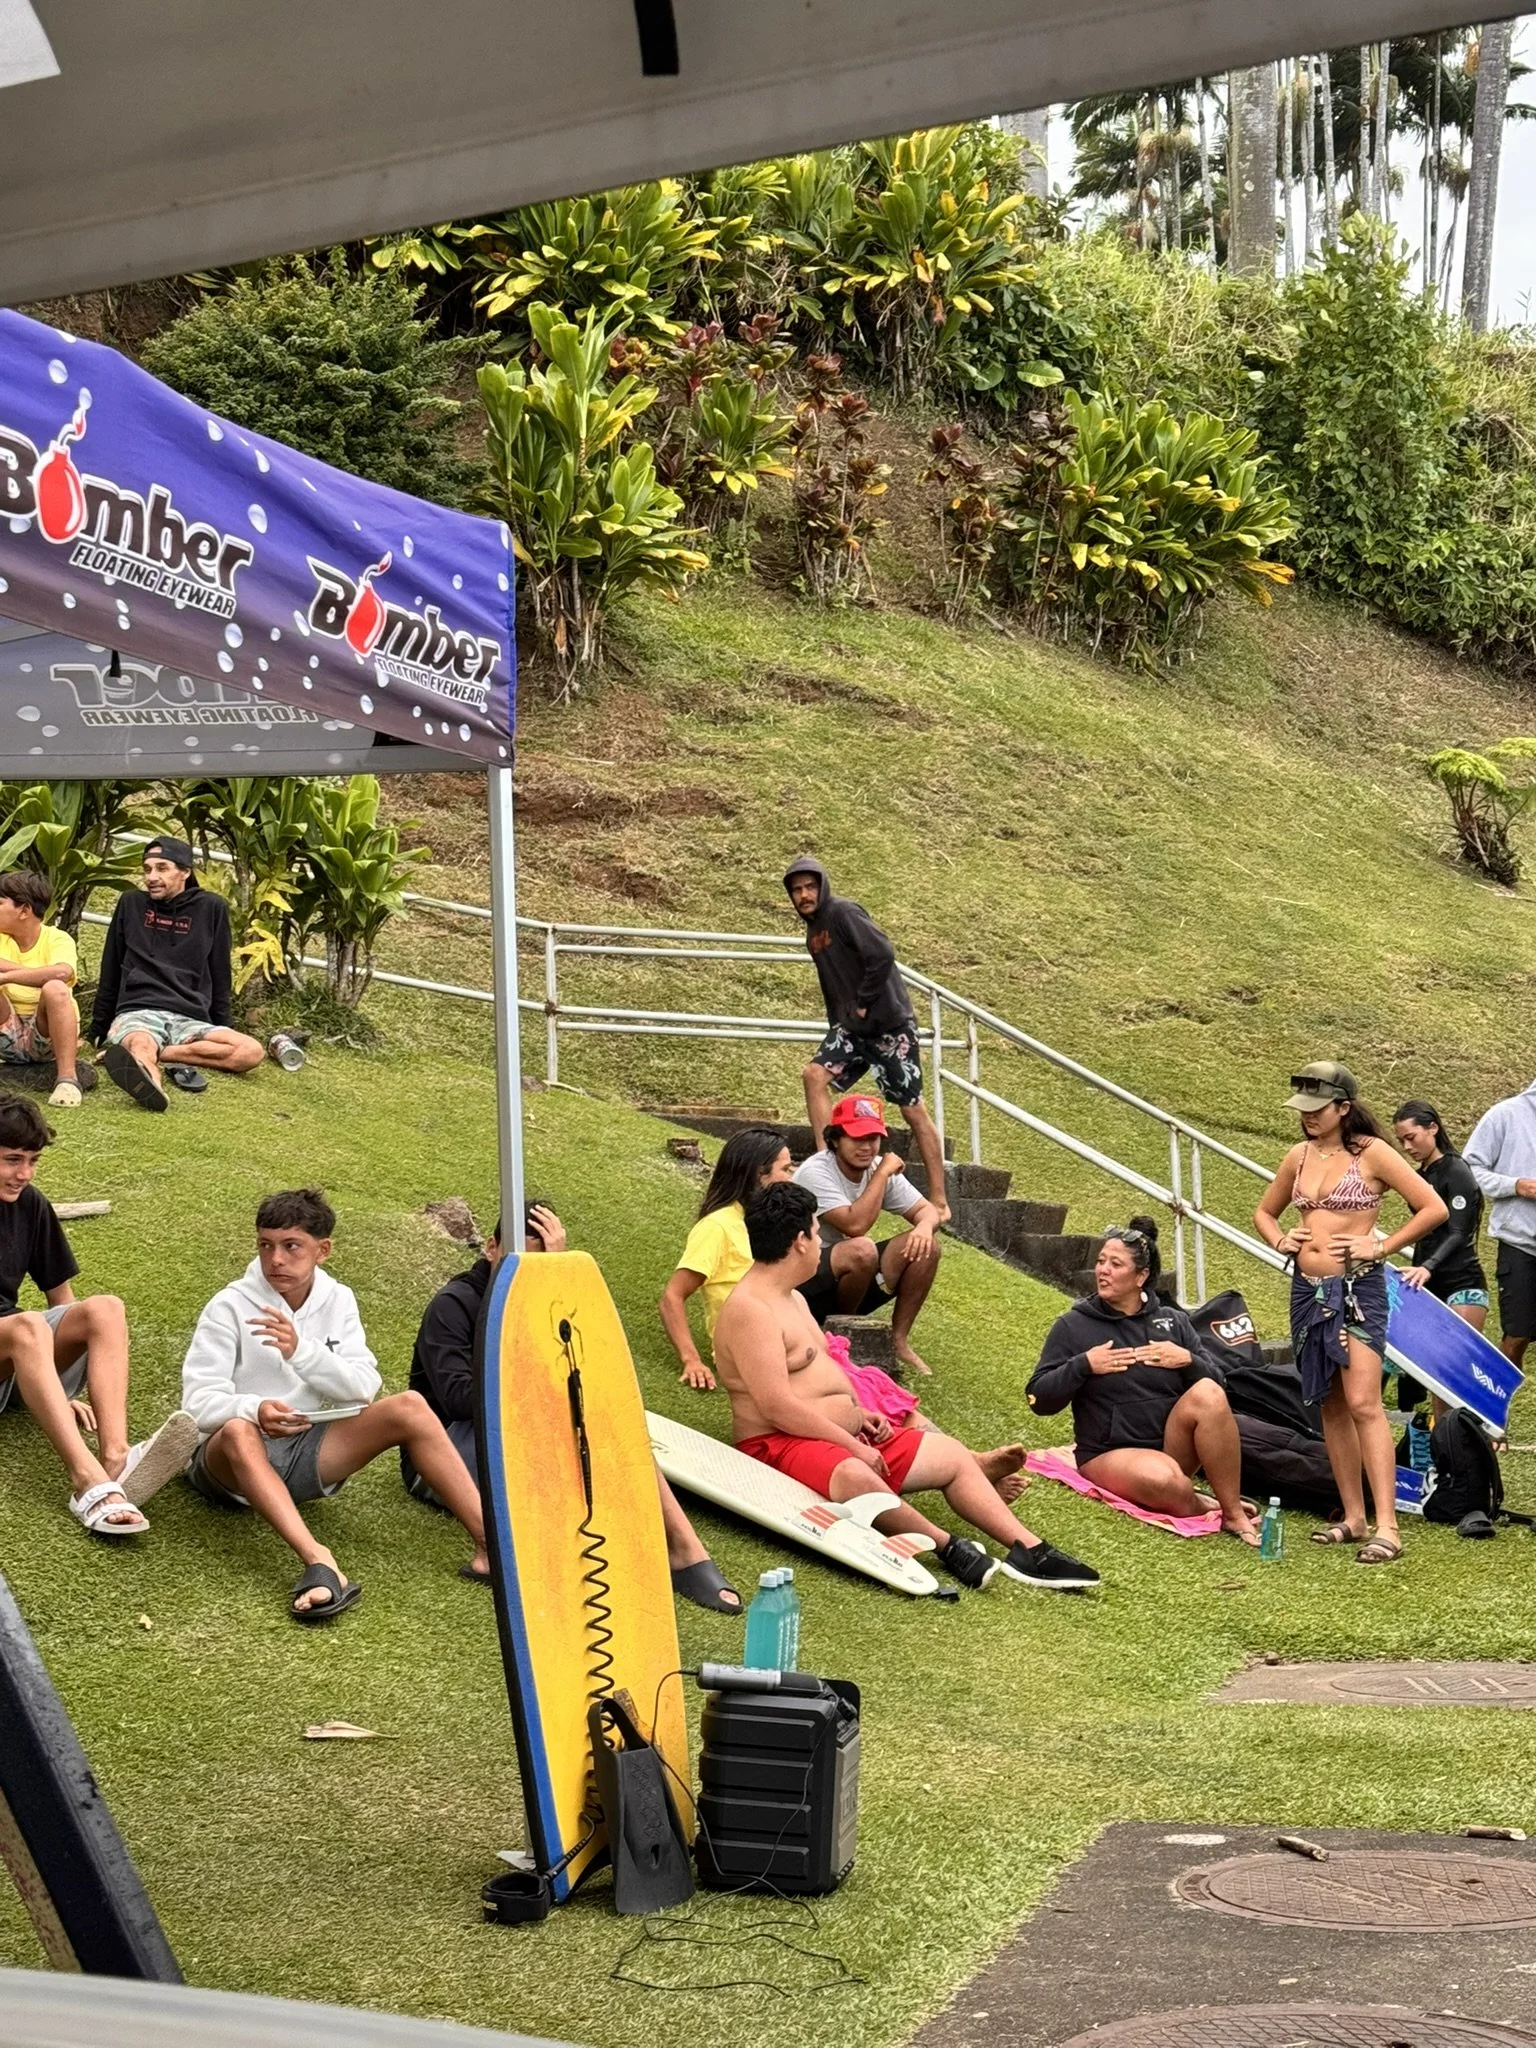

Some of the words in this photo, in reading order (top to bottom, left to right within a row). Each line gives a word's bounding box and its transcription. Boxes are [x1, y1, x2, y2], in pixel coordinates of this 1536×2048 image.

[70, 543, 158, 591] FLOATING
[157, 574, 236, 618] EYEWEAR
[307, 556, 500, 686] Bomber
[376, 657, 430, 688] FLOATING
[430, 676, 485, 704] EYEWEAR
